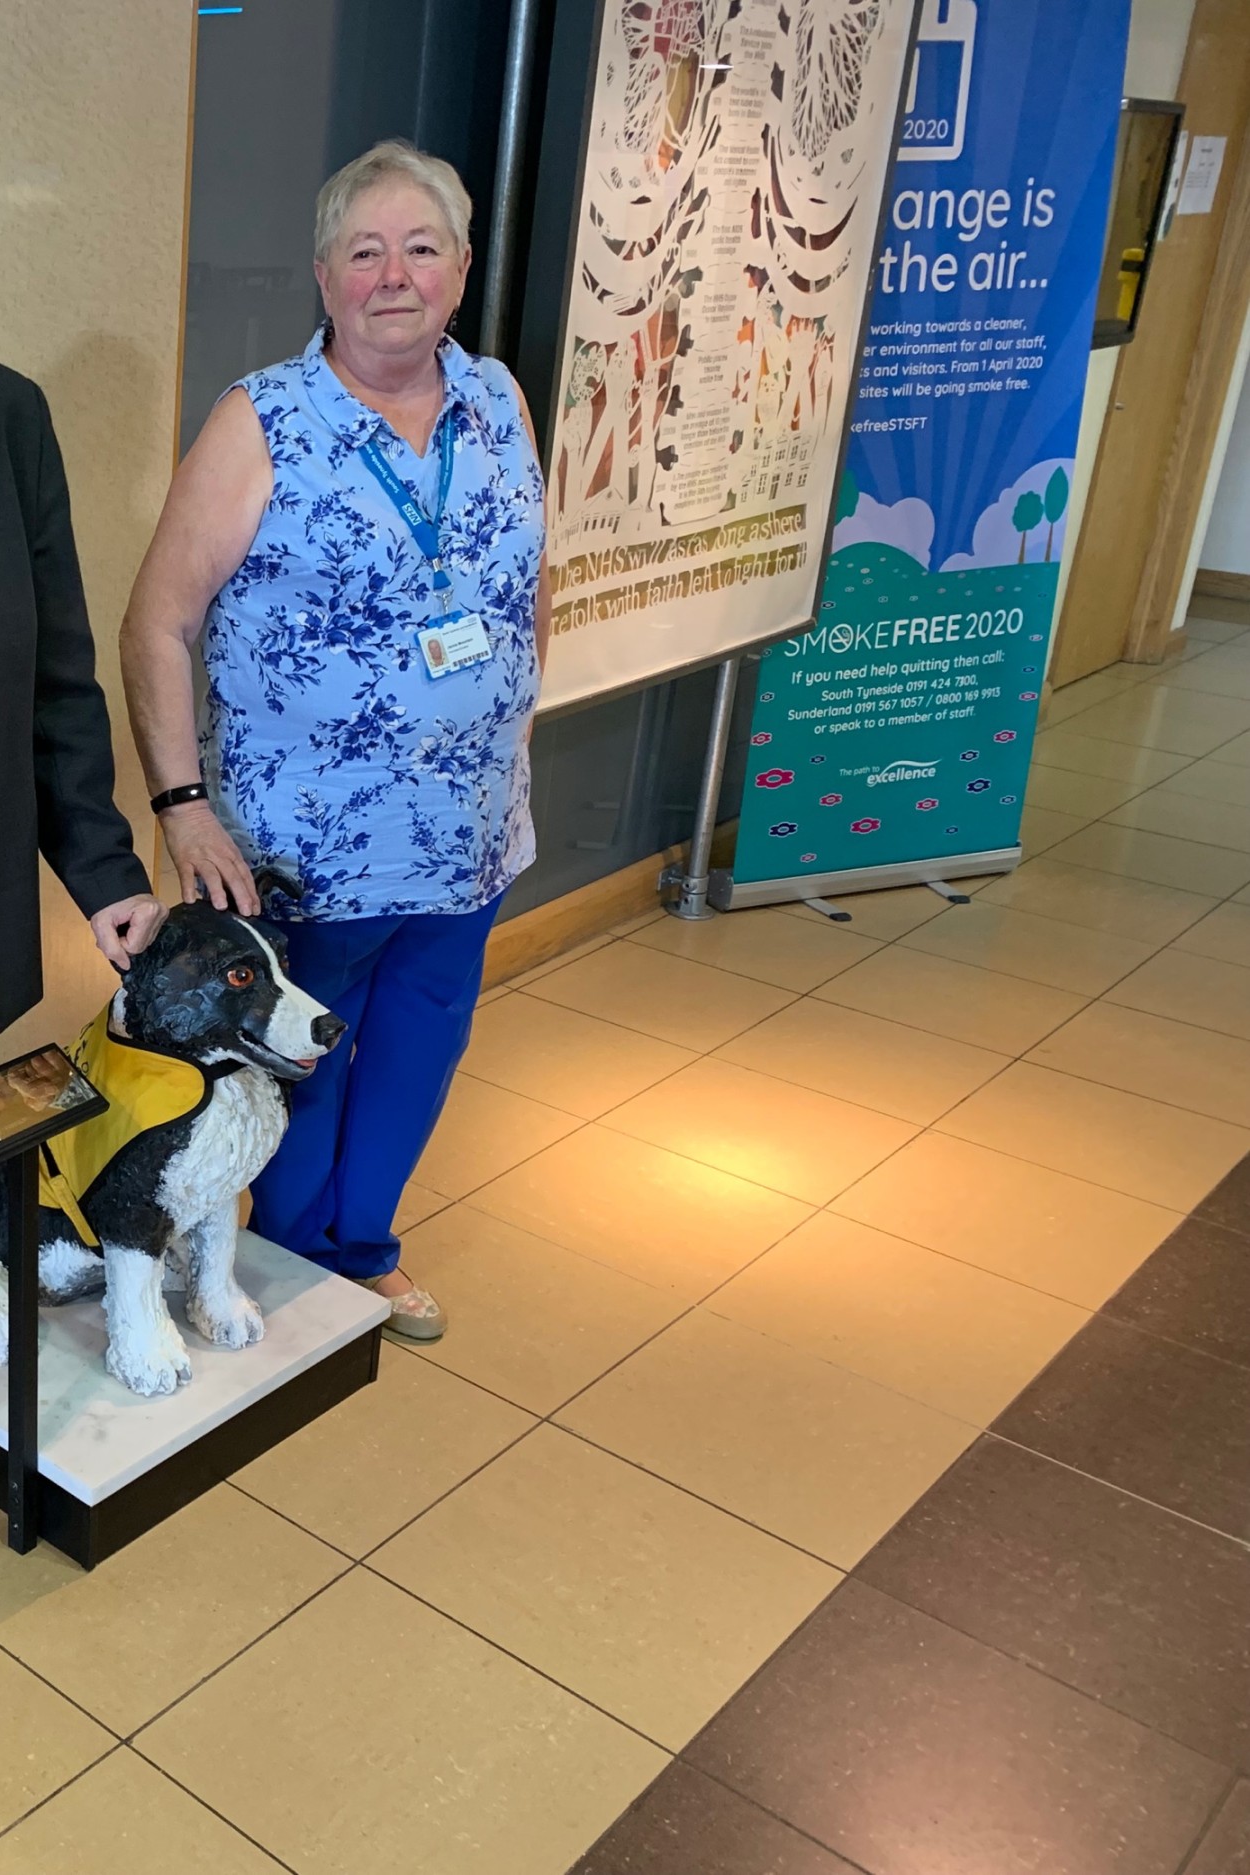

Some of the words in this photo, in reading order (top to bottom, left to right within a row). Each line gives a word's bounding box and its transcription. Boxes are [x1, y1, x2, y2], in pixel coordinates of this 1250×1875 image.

[903, 119, 949, 140] 2020
[892, 189, 1011, 242] ange
[1022, 177, 1056, 227] is
[879, 240, 958, 293] the
[968, 240, 1048, 291] air...
[870, 321, 921, 337] working
[926, 319, 971, 333] towards
[974, 322, 981, 332] a
[984, 318, 1027, 331] cleaner,
[863, 345, 878, 357] er
[880, 342, 957, 356] environment
[960, 339, 976, 352] for
[979, 338, 992, 351] all
[995, 340, 1013, 351] our
[1016, 335, 1046, 350] staff,
[859, 367, 870, 378] s
[873, 363, 898, 377] and
[902, 362, 948, 376] visitors.
[951, 360, 979, 374] From
[982, 359, 987, 371] 1
[988, 358, 1013, 374] April
[1016, 356, 1043, 370] 2020
[859, 386, 888, 399] sites
[892, 384, 913, 397] will
[916, 383, 931, 396] be
[935, 381, 965, 398] going
[968, 379, 1003, 393] smoke
[1006, 377, 1031, 390] free.
[404, 504, 420, 524] NHS
[556, 564, 582, 591] The
[585, 547, 627, 583] NHS
[768, 511, 802, 534] there
[569, 595, 600, 630] folk
[605, 585, 641, 616] with
[646, 575, 684, 605] faith
[688, 566, 711, 595] left
[733, 553, 771, 583] fight
[775, 548, 794, 574] for
[964, 608, 1024, 640] 2020
[791, 671, 802, 684] If
[806, 669, 831, 686] you
[835, 665, 867, 681] need
[870, 662, 897, 678] help
[901, 657, 950, 676] quitting
[954, 653, 979, 668] then
[982, 650, 1005, 665] call:
[821, 687, 854, 702] South
[857, 684, 904, 700] Tyneside
[906, 680, 928, 693] 0191
[931, 677, 951, 690] 424
[788, 705, 852, 721] Sunderland
[855, 702, 876, 714] 0191
[878, 699, 897, 711] 567
[900, 696, 924, 709] 1057
[926, 694, 932, 708] /
[936, 692, 962, 705] 0800
[964, 690, 979, 703] 169
[814, 724, 827, 735] or
[829, 721, 861, 734] speak
[864, 718, 876, 729] to
[878, 718, 885, 727] a
[888, 713, 932, 726] member
[935, 710, 947, 721] of
[949, 706, 976, 719] staff.
[839, 768, 852, 776] The
[853, 767, 870, 776] path
[867, 767, 936, 786] excellence
